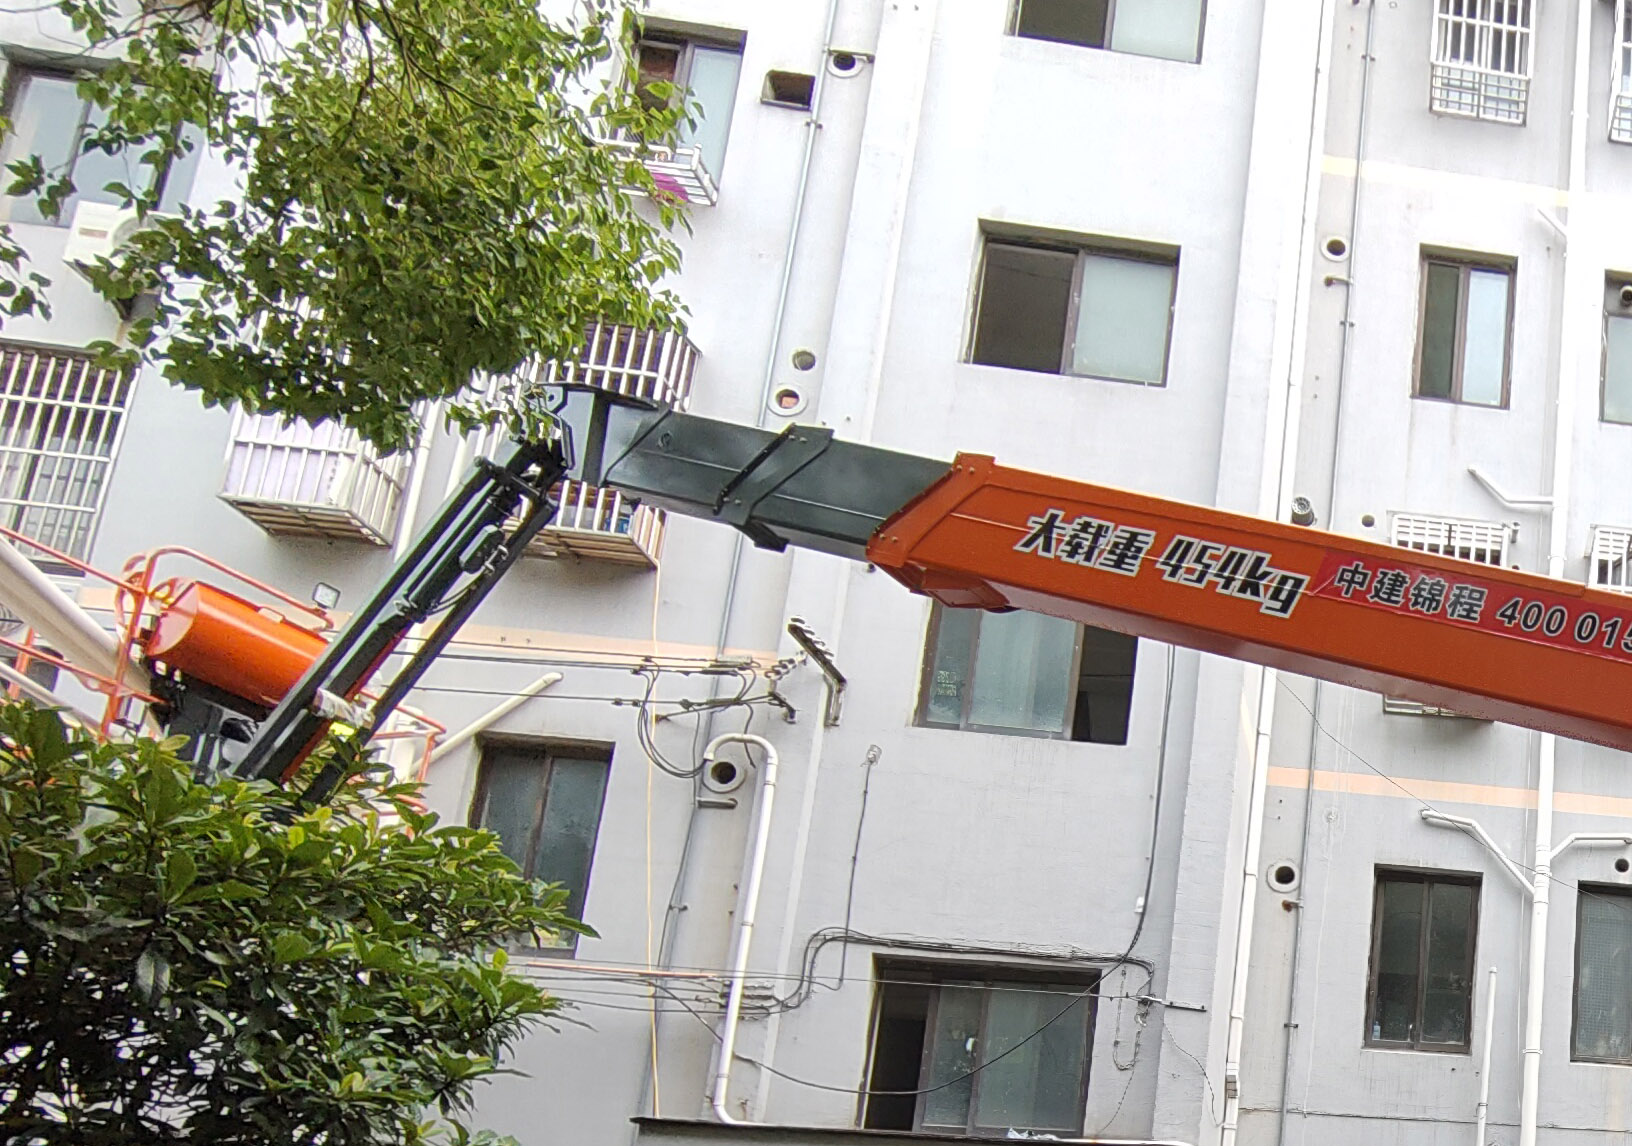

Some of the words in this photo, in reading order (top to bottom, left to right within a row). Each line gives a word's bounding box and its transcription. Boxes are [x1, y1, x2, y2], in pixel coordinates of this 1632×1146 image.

[1013, 508, 1156, 577] 大载重
[1156, 534, 1310, 618] 454kg
[1334, 562, 1487, 623] 中建锦程
[1496, 597, 1567, 637] 400
